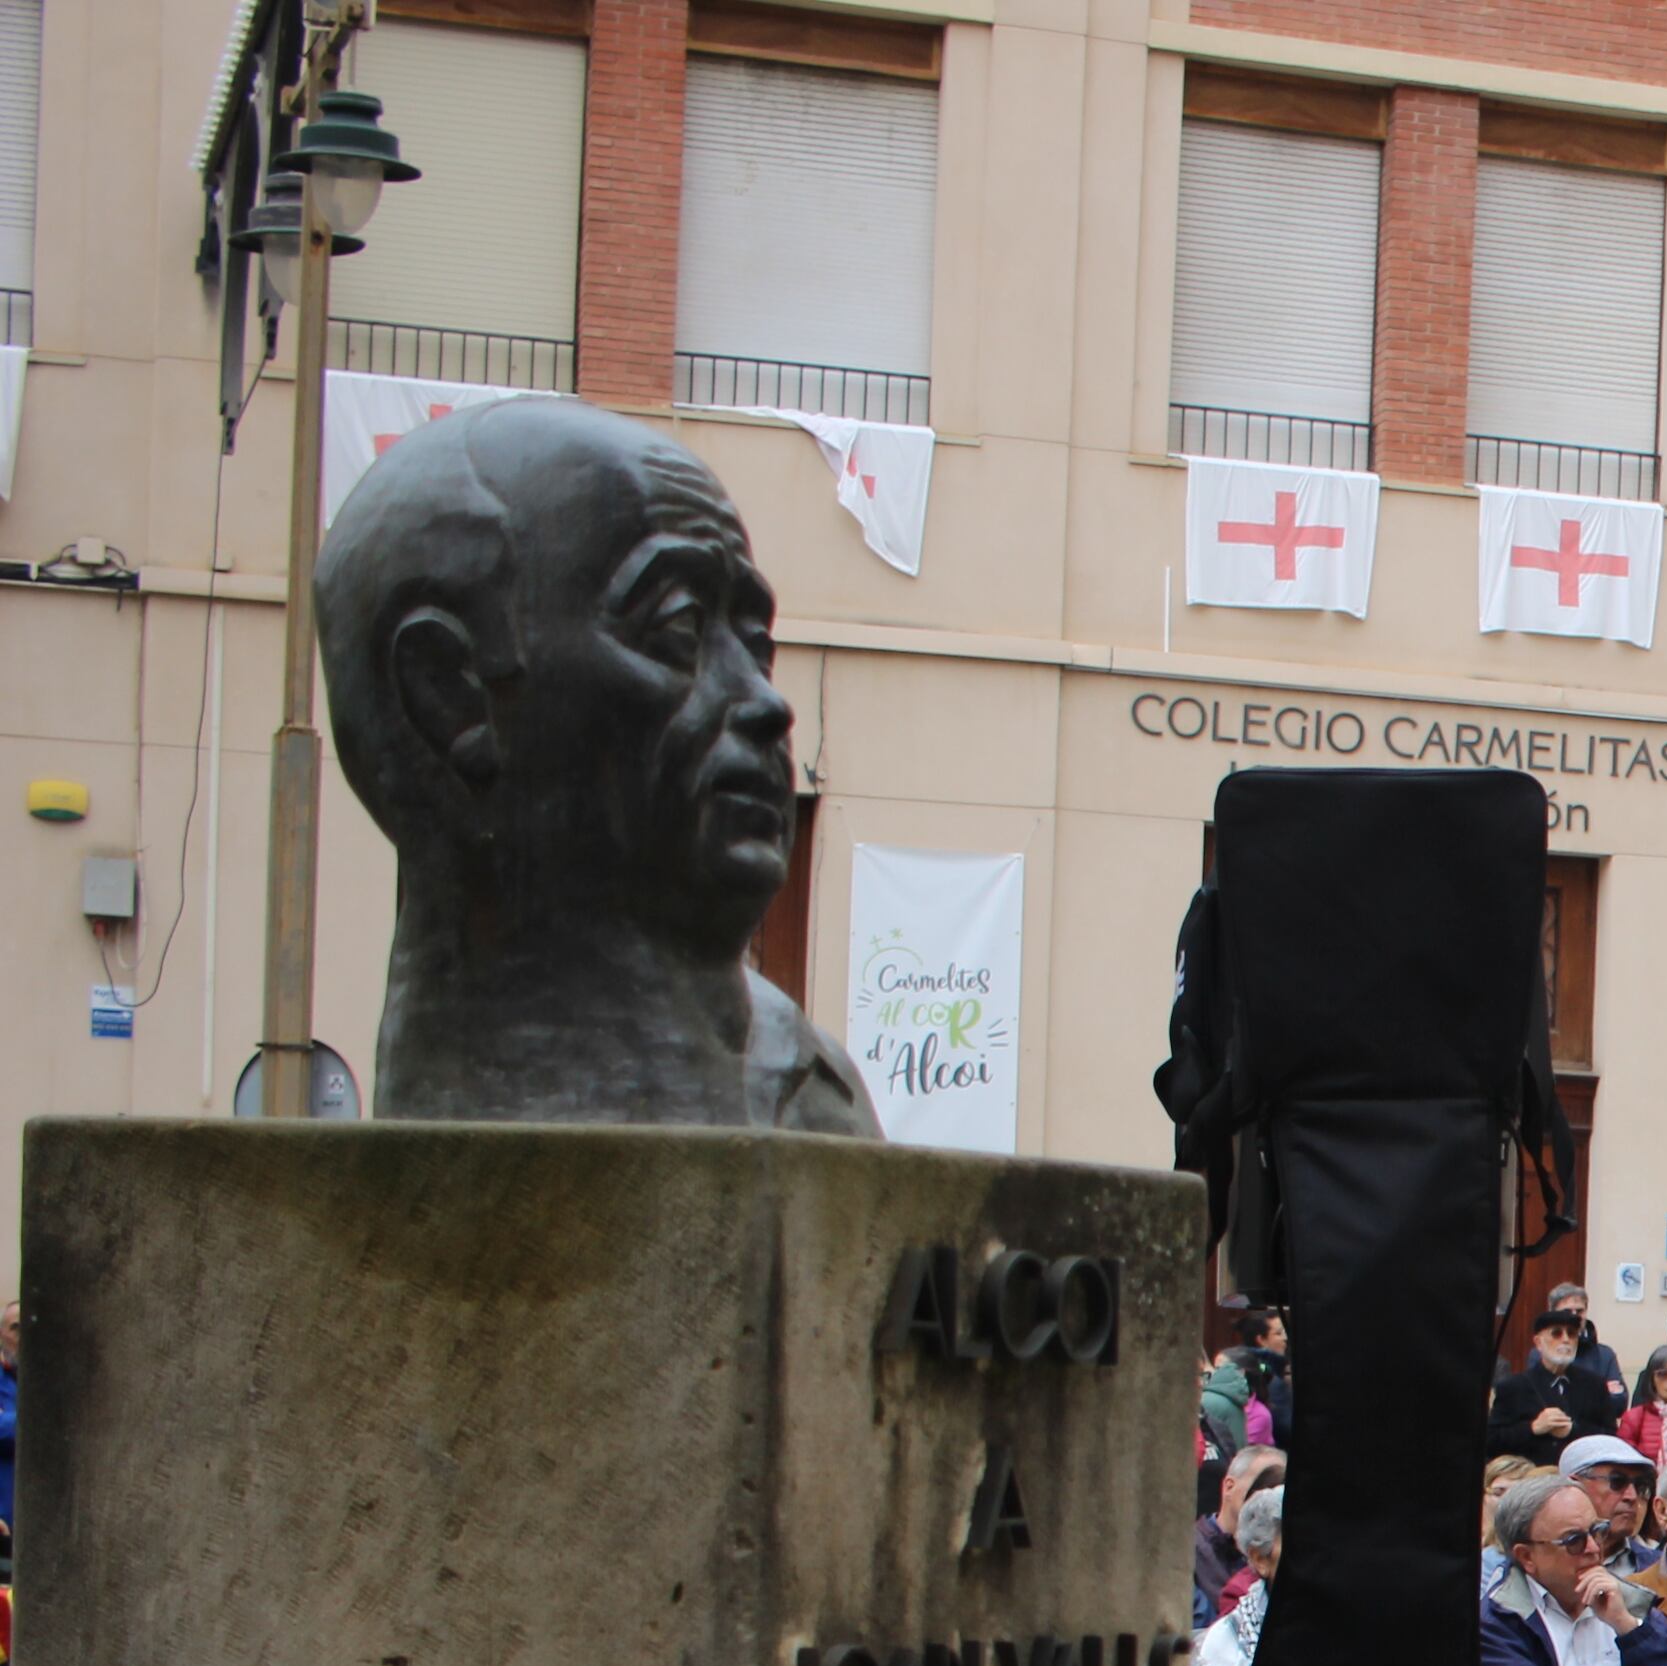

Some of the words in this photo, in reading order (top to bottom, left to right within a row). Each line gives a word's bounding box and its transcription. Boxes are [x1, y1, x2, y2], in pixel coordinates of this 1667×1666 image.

[1131, 693, 1365, 754] COLEGIO
[878, 962, 991, 994] Carmelites
[866, 1032, 993, 1096] d'Alcoi
[876, 1246, 1120, 1367] ALCOI
[966, 1440, 1033, 1551] A
